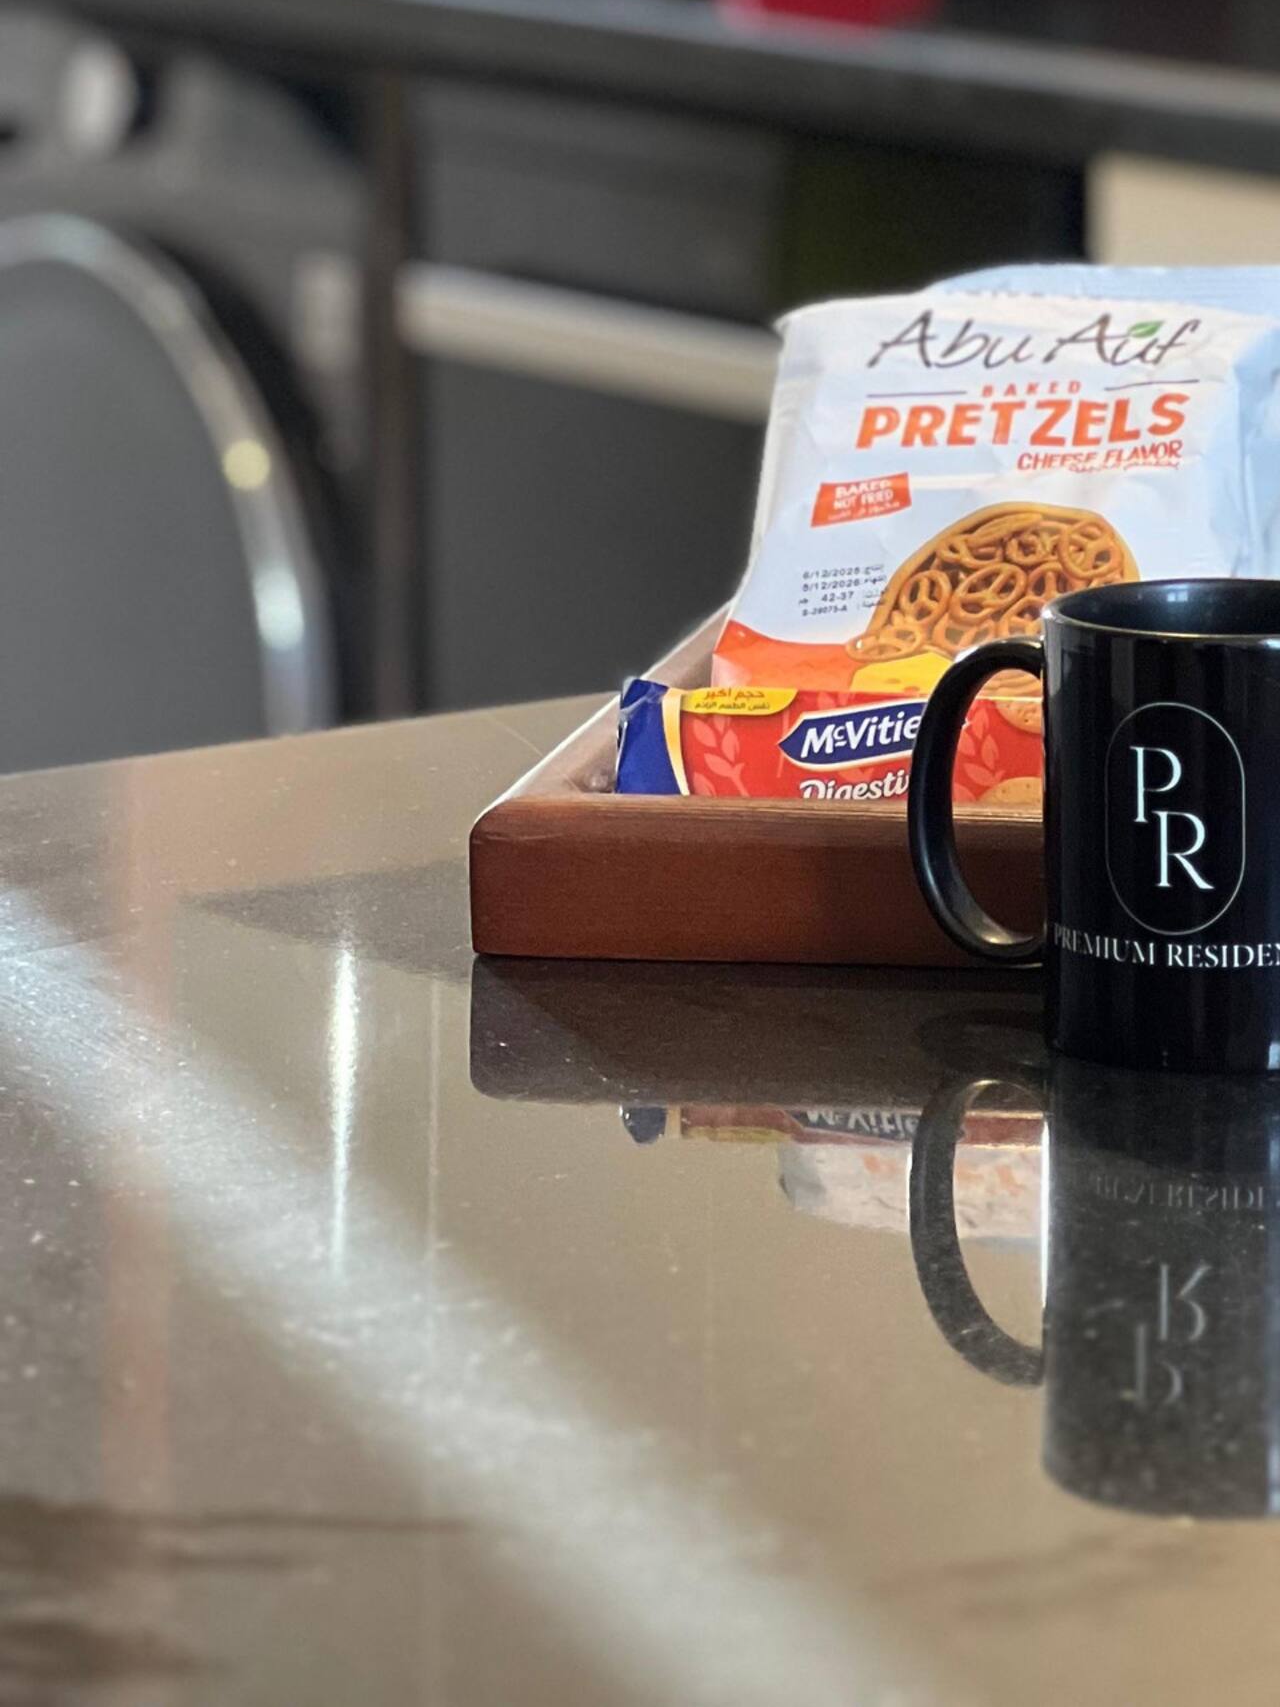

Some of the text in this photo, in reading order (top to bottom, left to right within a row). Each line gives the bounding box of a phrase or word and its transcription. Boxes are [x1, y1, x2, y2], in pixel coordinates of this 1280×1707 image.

[866, 308, 1202, 369] Abu Auf
[981, 380, 1082, 398] BAKED
[856, 392, 1190, 450] PRETZELS
[1103, 439, 1183, 466] FLAVOR
[800, 711, 922, 759] McVitie
[799, 769, 910, 800] Digesti
[1129, 745, 1183, 824] P
[1151, 810, 1215, 891] R
[1053, 922, 1156, 966] PREMIUM
